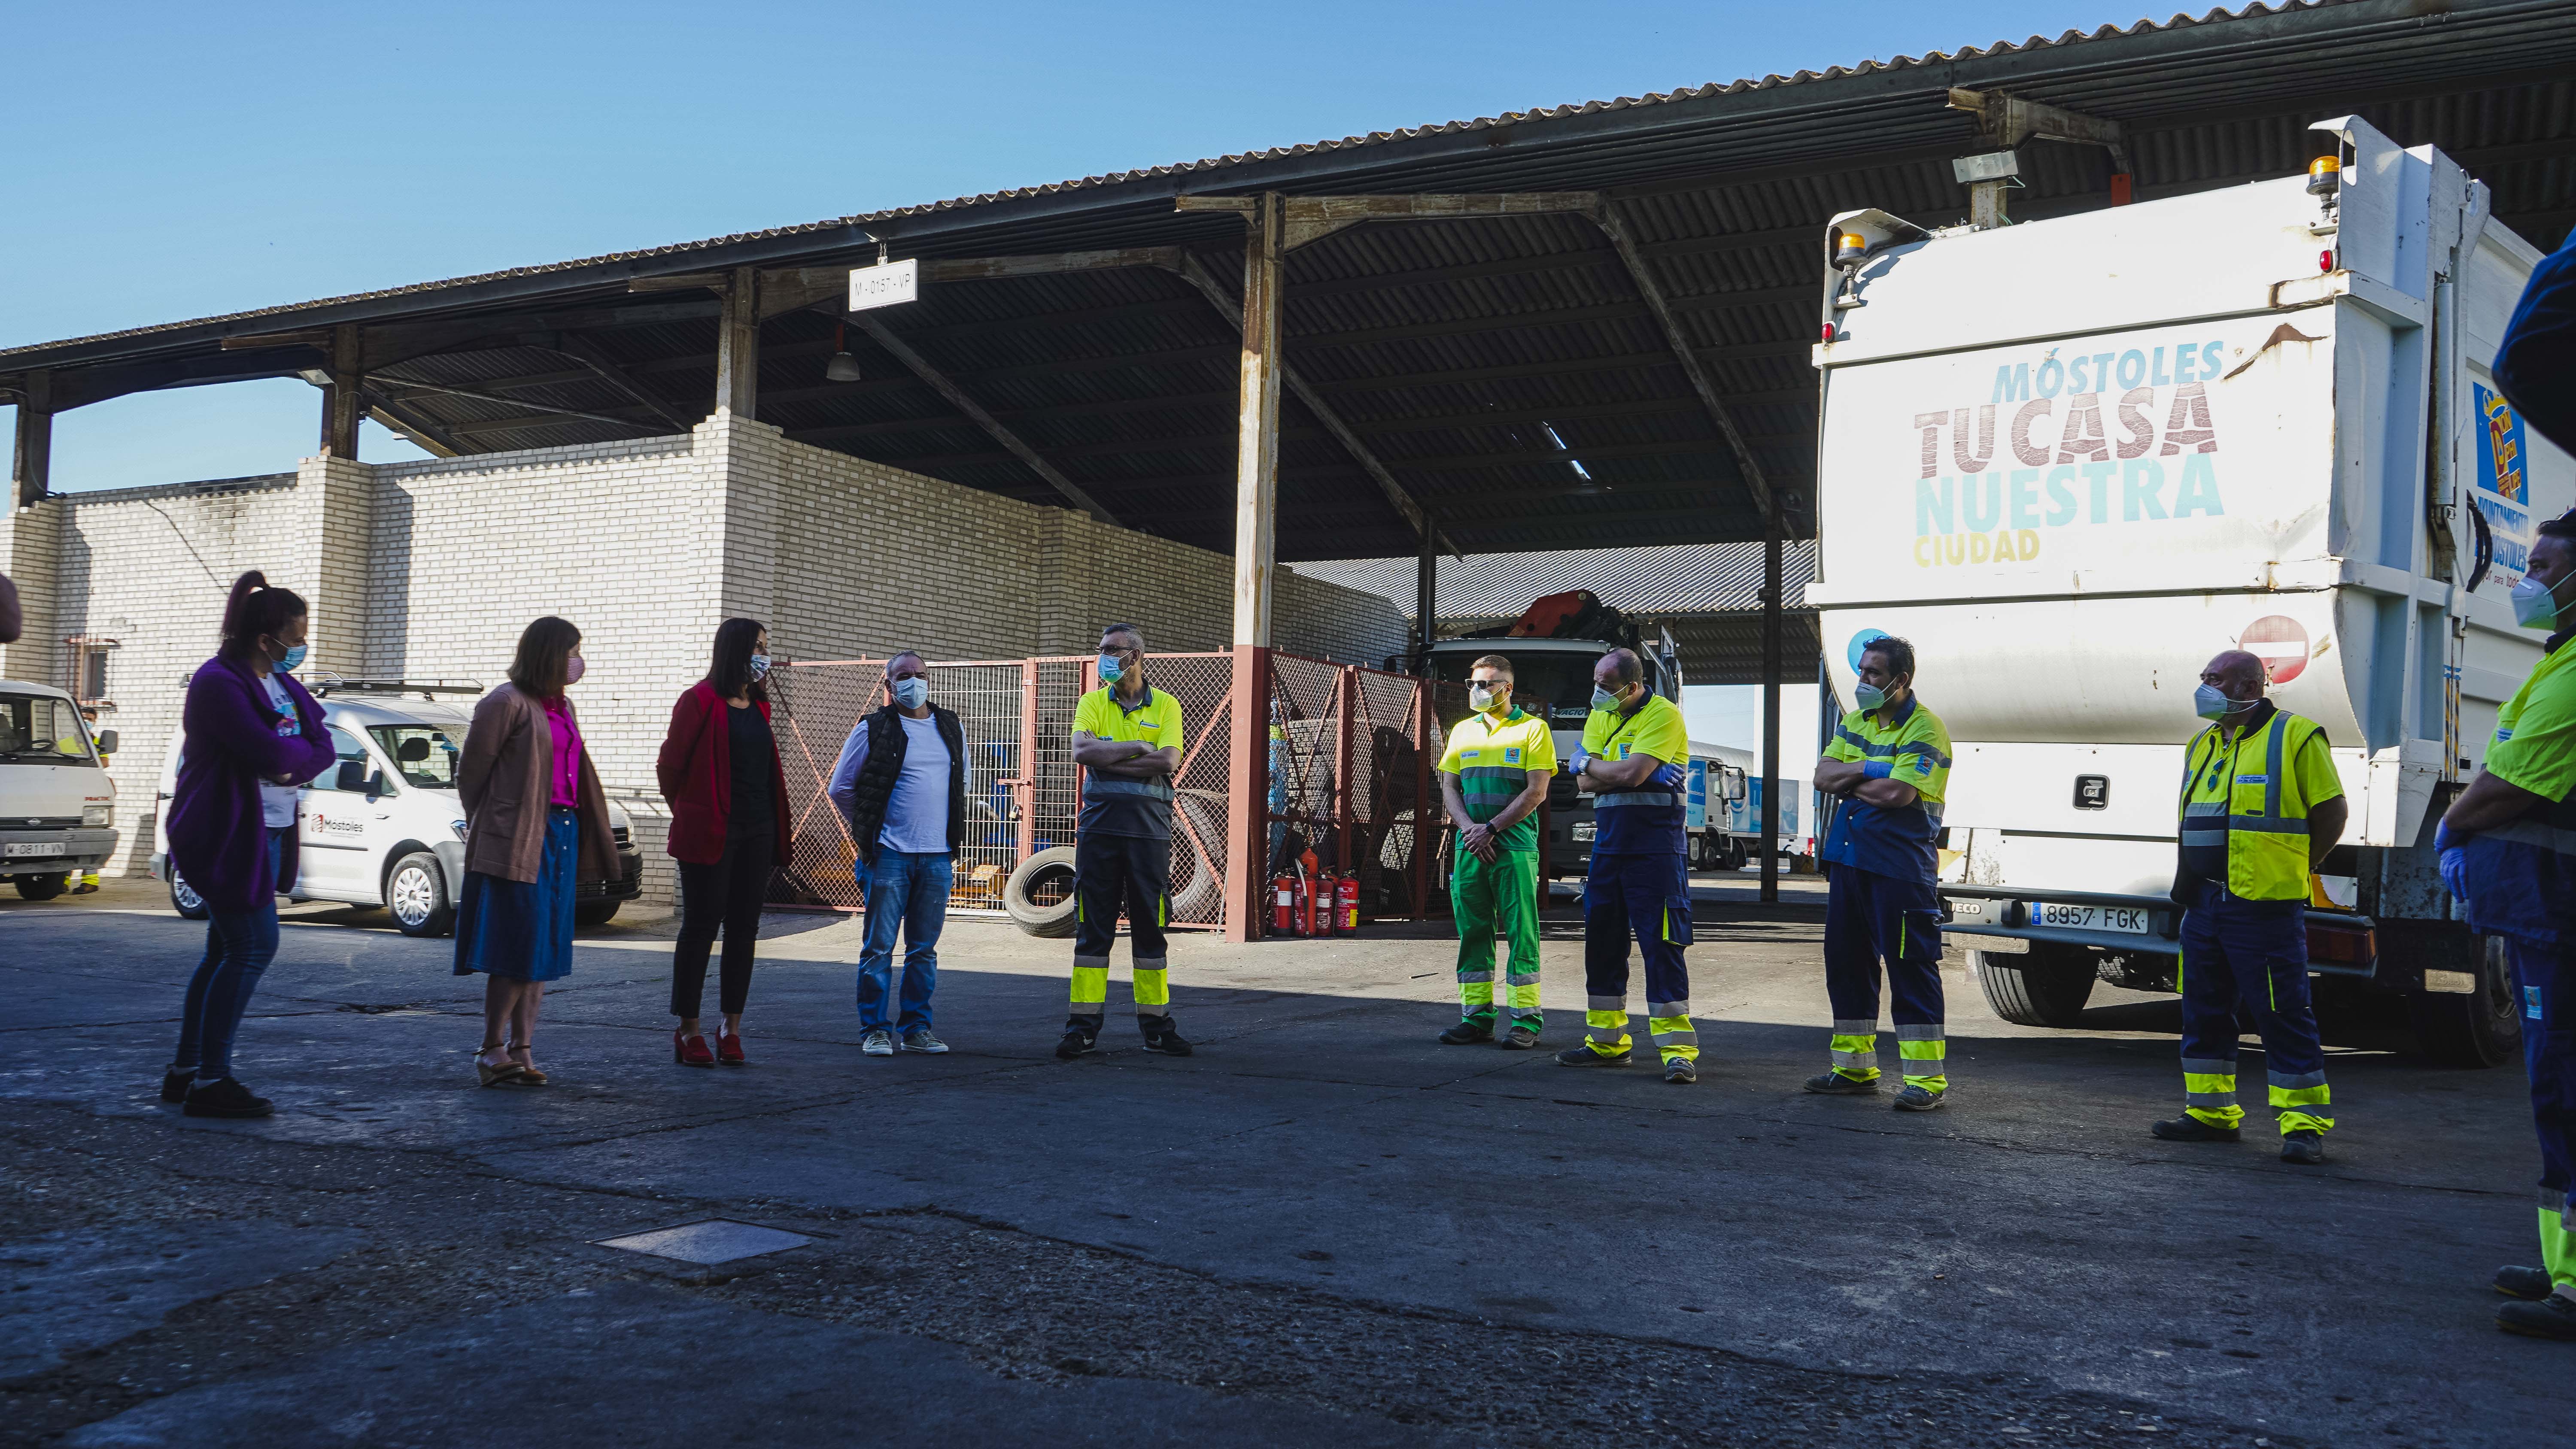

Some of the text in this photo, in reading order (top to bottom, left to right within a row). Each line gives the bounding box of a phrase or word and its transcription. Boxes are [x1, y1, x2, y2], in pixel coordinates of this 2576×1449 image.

[855, 274, 910, 297] M 0157 VP
[1991, 341, 2224, 404] MÓSTOLES
[1914, 381, 2218, 479] TU CASA
[1916, 452, 2225, 536] NUESTRA
[1914, 529, 2041, 569] CIUDAD
[2491, 530, 2527, 573] ÓSTOLES
[325, 819, 364, 832] Móstoles
[2047, 905, 2142, 930] 8957 FGK
